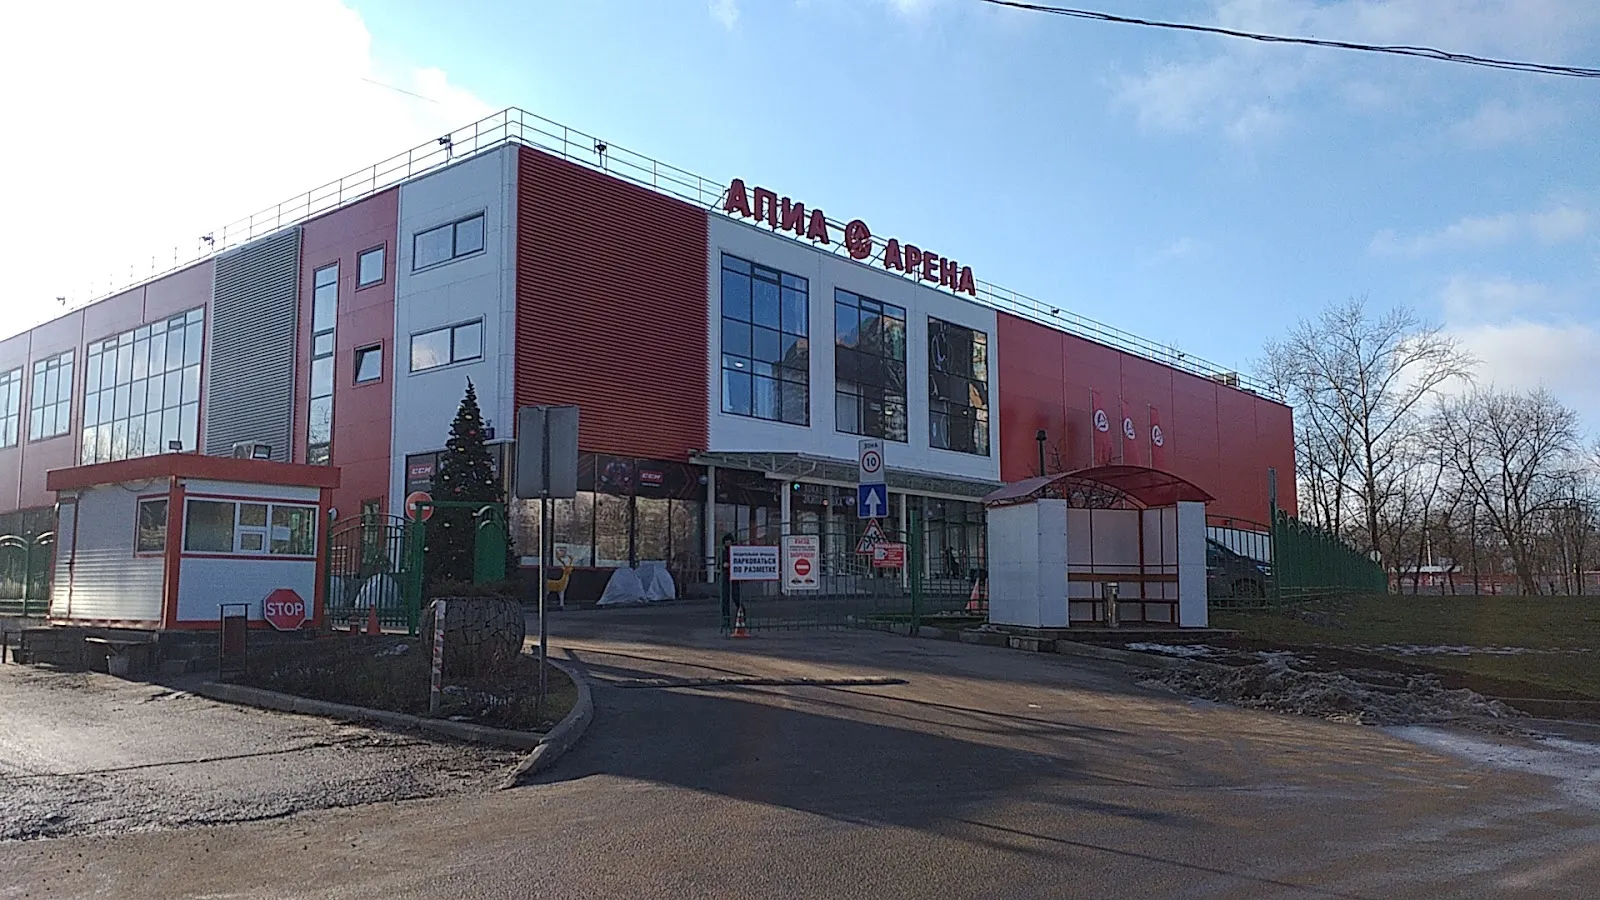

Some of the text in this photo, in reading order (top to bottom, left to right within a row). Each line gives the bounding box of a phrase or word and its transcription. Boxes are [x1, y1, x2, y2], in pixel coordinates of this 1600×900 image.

[724, 178, 976, 297] АПИА АРЕНА
[867, 457, 876, 467] 10
[744, 565, 776, 573] РАЗМЕТКЕ
[266, 602, 303, 616] STOP
